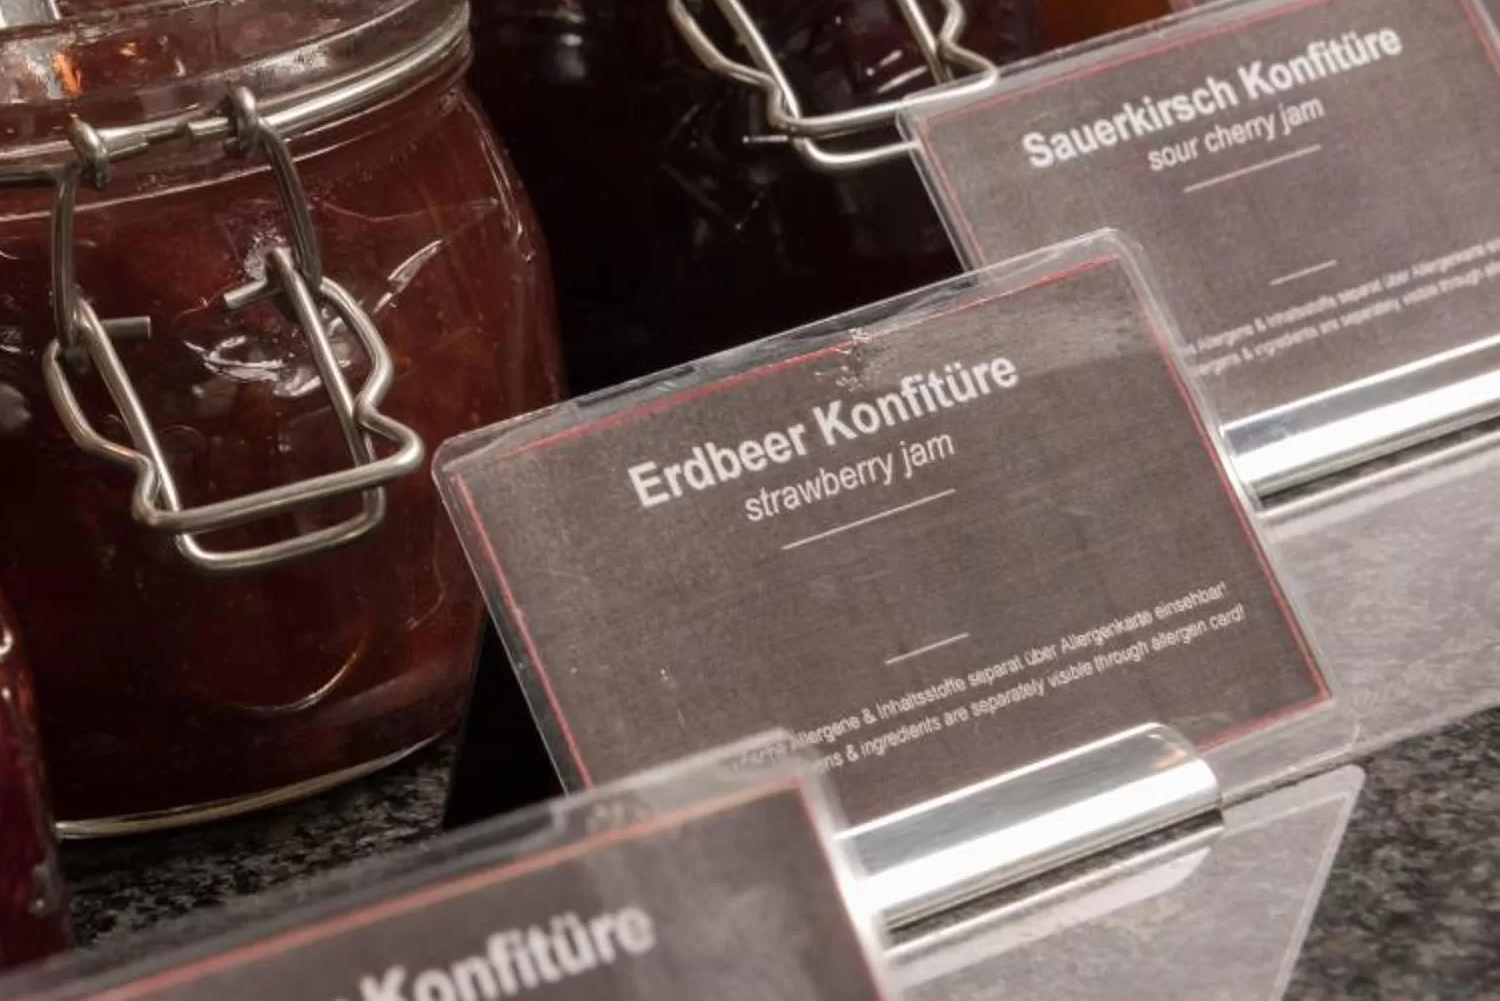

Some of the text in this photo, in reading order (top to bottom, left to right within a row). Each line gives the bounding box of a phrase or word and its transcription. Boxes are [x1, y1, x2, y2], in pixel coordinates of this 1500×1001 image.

[1022, 27, 1403, 168] Sauerkirsch Konfitüre
[1147, 97, 1326, 172] sour cherry jam
[627, 356, 1019, 507] Erdbeer Konfitüre
[744, 432, 956, 522] strawberry jam
[860, 707, 879, 725] &
[875, 677, 967, 719] Inhaltsstoffe
[966, 656, 1025, 687] separat
[1024, 644, 1058, 667] über
[1060, 610, 1153, 654] Allergenkarte
[860, 717, 943, 757] ingredients
[943, 705, 970, 727] are
[970, 678, 1045, 717] separately
[1047, 660, 1094, 689] visible
[1093, 640, 1150, 673] through
[1151, 620, 1208, 652] allergen
[358, 904, 658, 1001] Konfitüre
